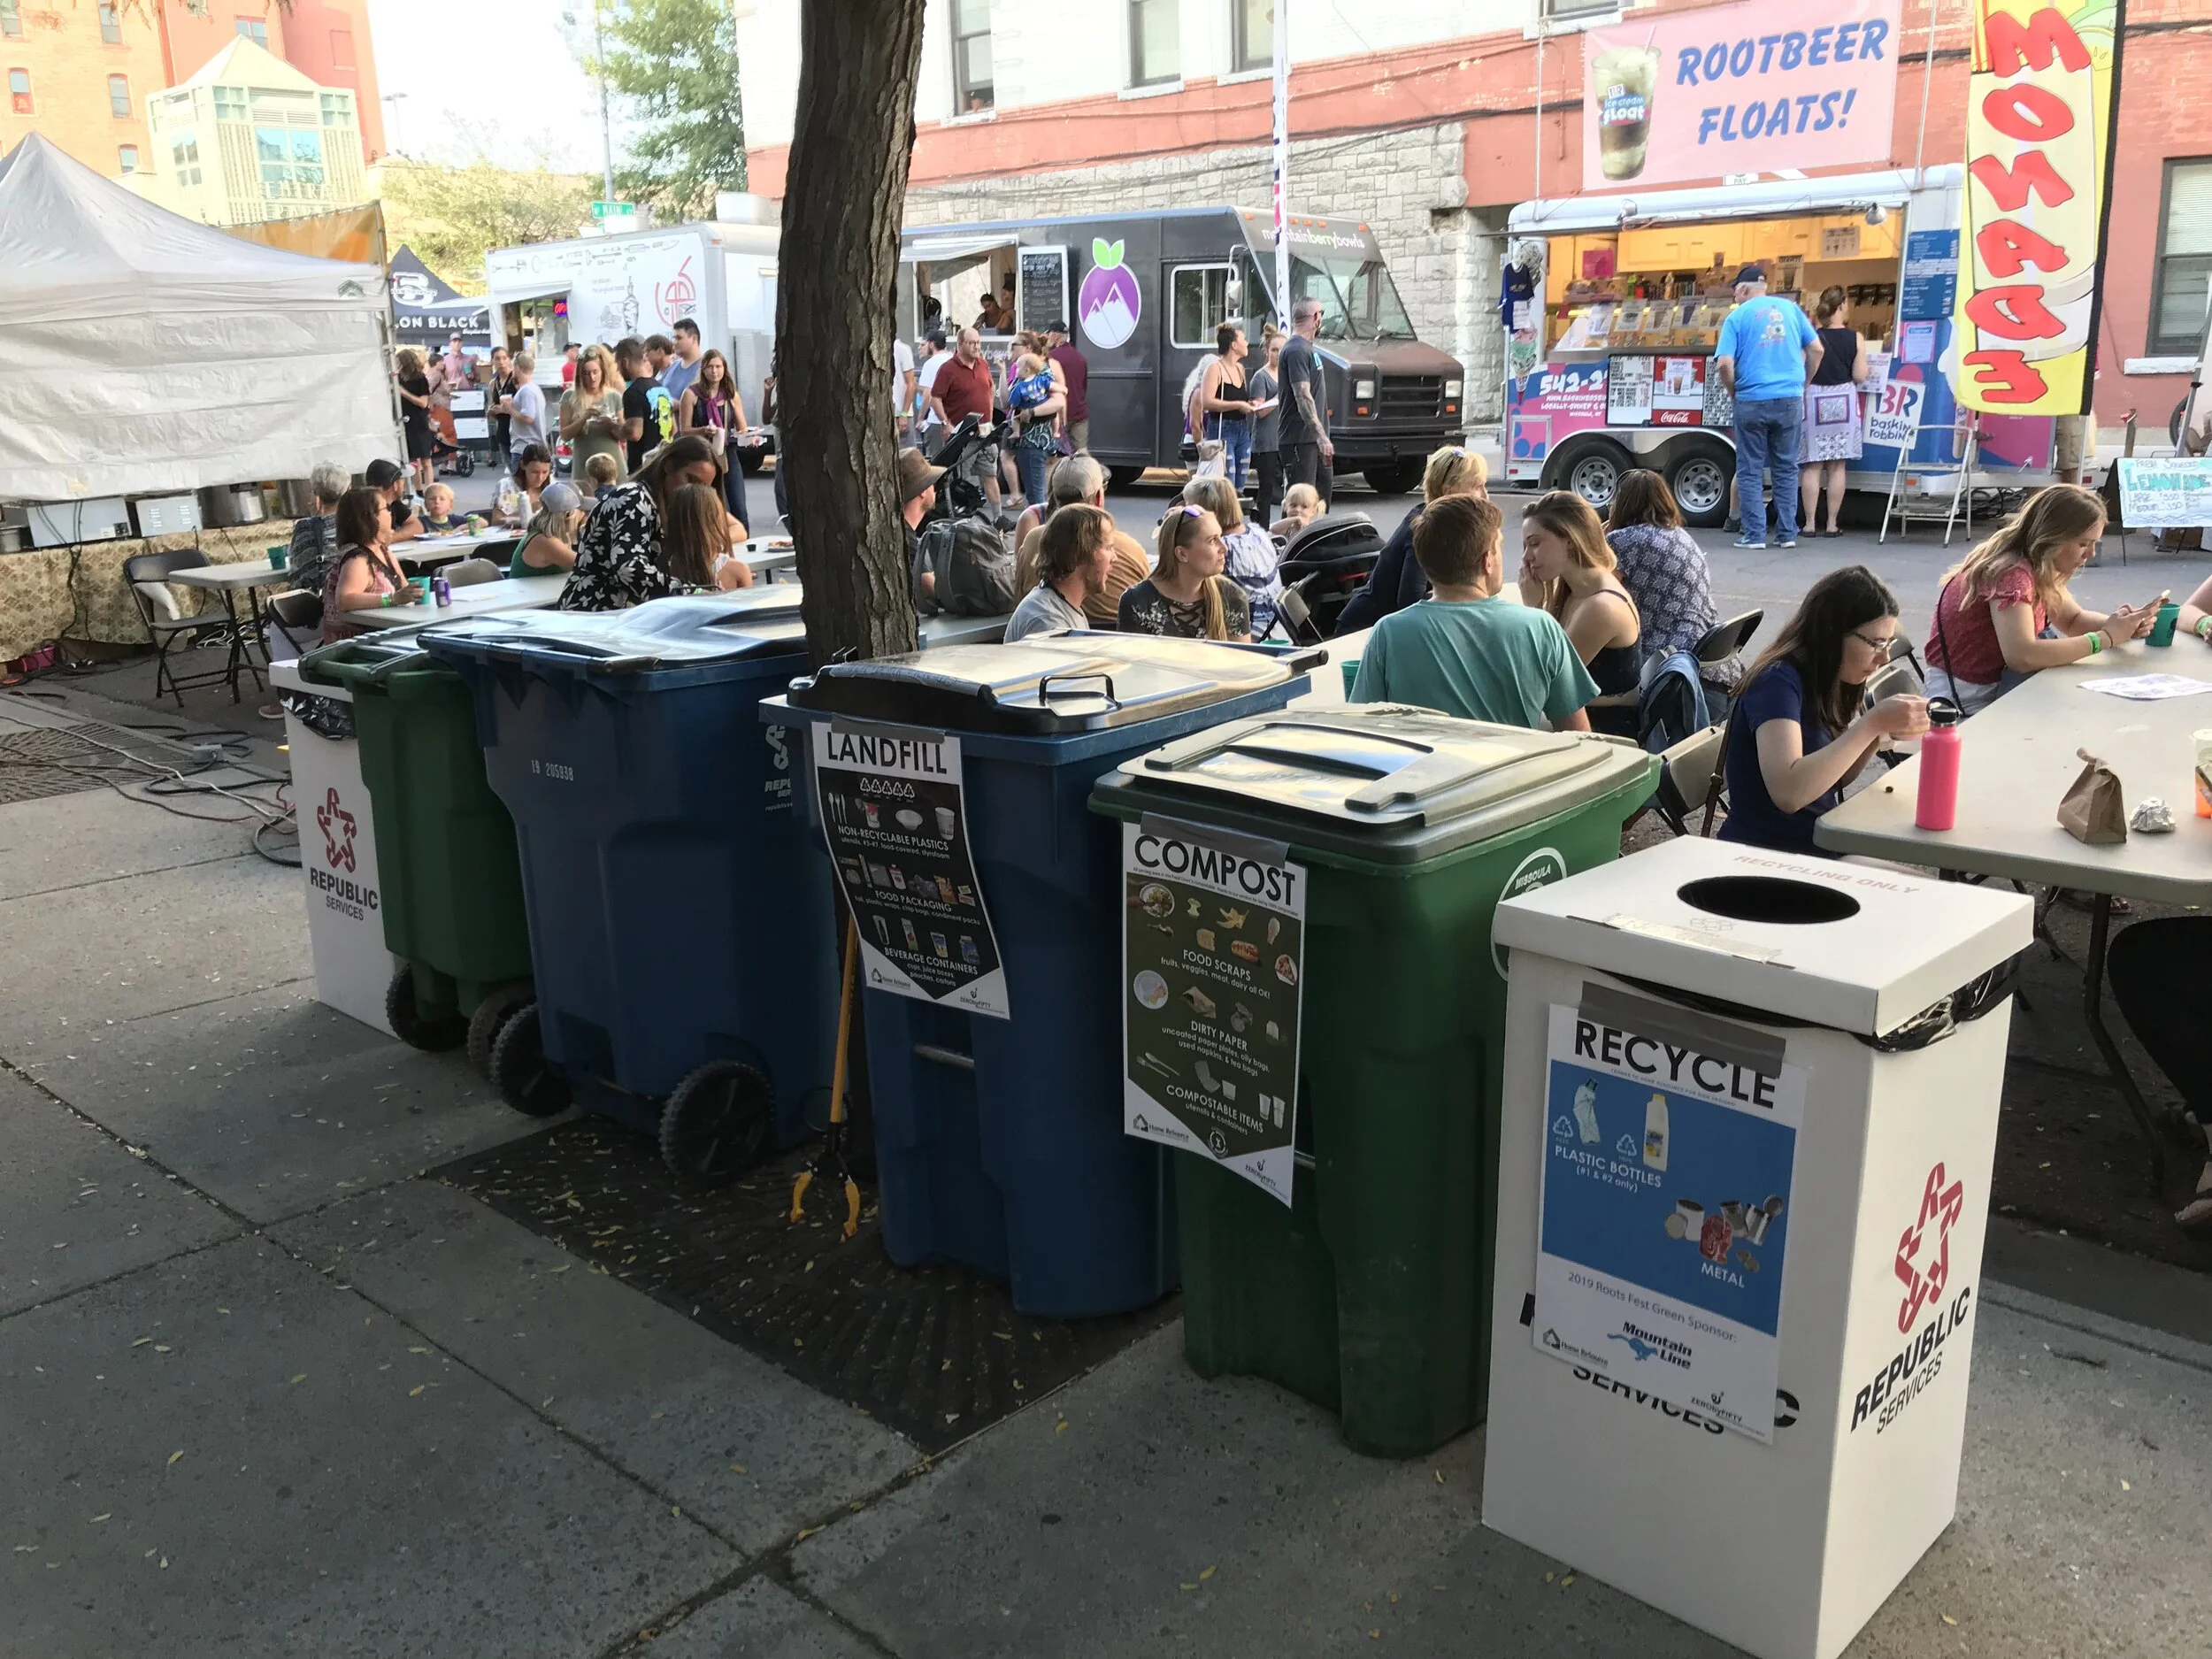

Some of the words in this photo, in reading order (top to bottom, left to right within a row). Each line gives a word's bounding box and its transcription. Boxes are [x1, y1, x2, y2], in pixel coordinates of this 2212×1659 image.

[1676, 18, 1889, 87] ROOTBEER
[1697, 88, 1857, 145] FLOATS!
[603, 204, 622, 216] MAIN
[1261, 228, 1365, 249] mntainberrybowls
[427, 316, 480, 329] BLACK
[1540, 370, 1608, 396] 542-2
[1870, 417, 1911, 432] baskin
[1870, 429, 1909, 443] robbin
[827, 733, 947, 774] LANDFILL
[838, 825, 910, 845] NON-RECYCLABLE
[911, 837, 949, 852] PLASTICS
[1134, 834, 1295, 906] COMPOST
[1515, 864, 1551, 890] MISSOULA
[1734, 856, 1854, 881] RECYCLING
[1855, 878, 1921, 894] ONLY
[310, 867, 378, 910] REPUBLIC
[875, 890, 898, 902] FOOD
[901, 895, 952, 912] PACKAGING
[326, 895, 364, 921] SERVICES
[884, 947, 925, 964] BEVERAGE
[926, 956, 979, 975] CONTAINERS
[1183, 949, 1212, 967] FOOD
[1214, 959, 1251, 982] SCRAPS
[1181, 963, 1210, 978] veggies,
[1211, 972, 1230, 984] meat,
[1231, 978, 1248, 991] dairy
[1248, 986, 1257, 995] all
[1258, 988, 1271, 1000] OK!
[1162, 1027, 1197, 1041] uncoated
[1198, 1036, 1218, 1049] paper
[1240, 1052, 1252, 1064] oily
[1191, 1020, 1217, 1038] DIRTY
[1219, 1030, 1248, 1052] PAPER
[1179, 1041, 1195, 1051] used
[1230, 1058, 1241, 1070] tea
[1242, 1063, 1258, 1077] bags
[1575, 1020, 1775, 1109] RECYCLE
[1166, 1085, 1237, 1120] COMPOSTABLE
[1240, 1113, 1264, 1133] ITEMS
[1186, 1102, 1210, 1118] utensils
[1216, 1114, 1248, 1135] containers
[1555, 1145, 1606, 1170] PLASTIC
[1609, 1161, 1662, 1190] BOTTLES
[1593, 1171, 1599, 1179] &
[1601, 1174, 1613, 1184] #2
[1615, 1177, 1638, 1194] only)
[1701, 1263, 1745, 1289] METAL
[1568, 1272, 1594, 1288] 2019
[1596, 1281, 1625, 1302] Roots
[1628, 1293, 1649, 1310] Fest
[1652, 1303, 1685, 1324] Green
[1687, 1316, 1737, 1343] Sponsor:
[1623, 1321, 1692, 1356] Mountain
[1660, 1349, 1691, 1370] Line
[1850, 1286, 1970, 1433] REPUBLIC
[1877, 1351, 1943, 1434] SERVICES
